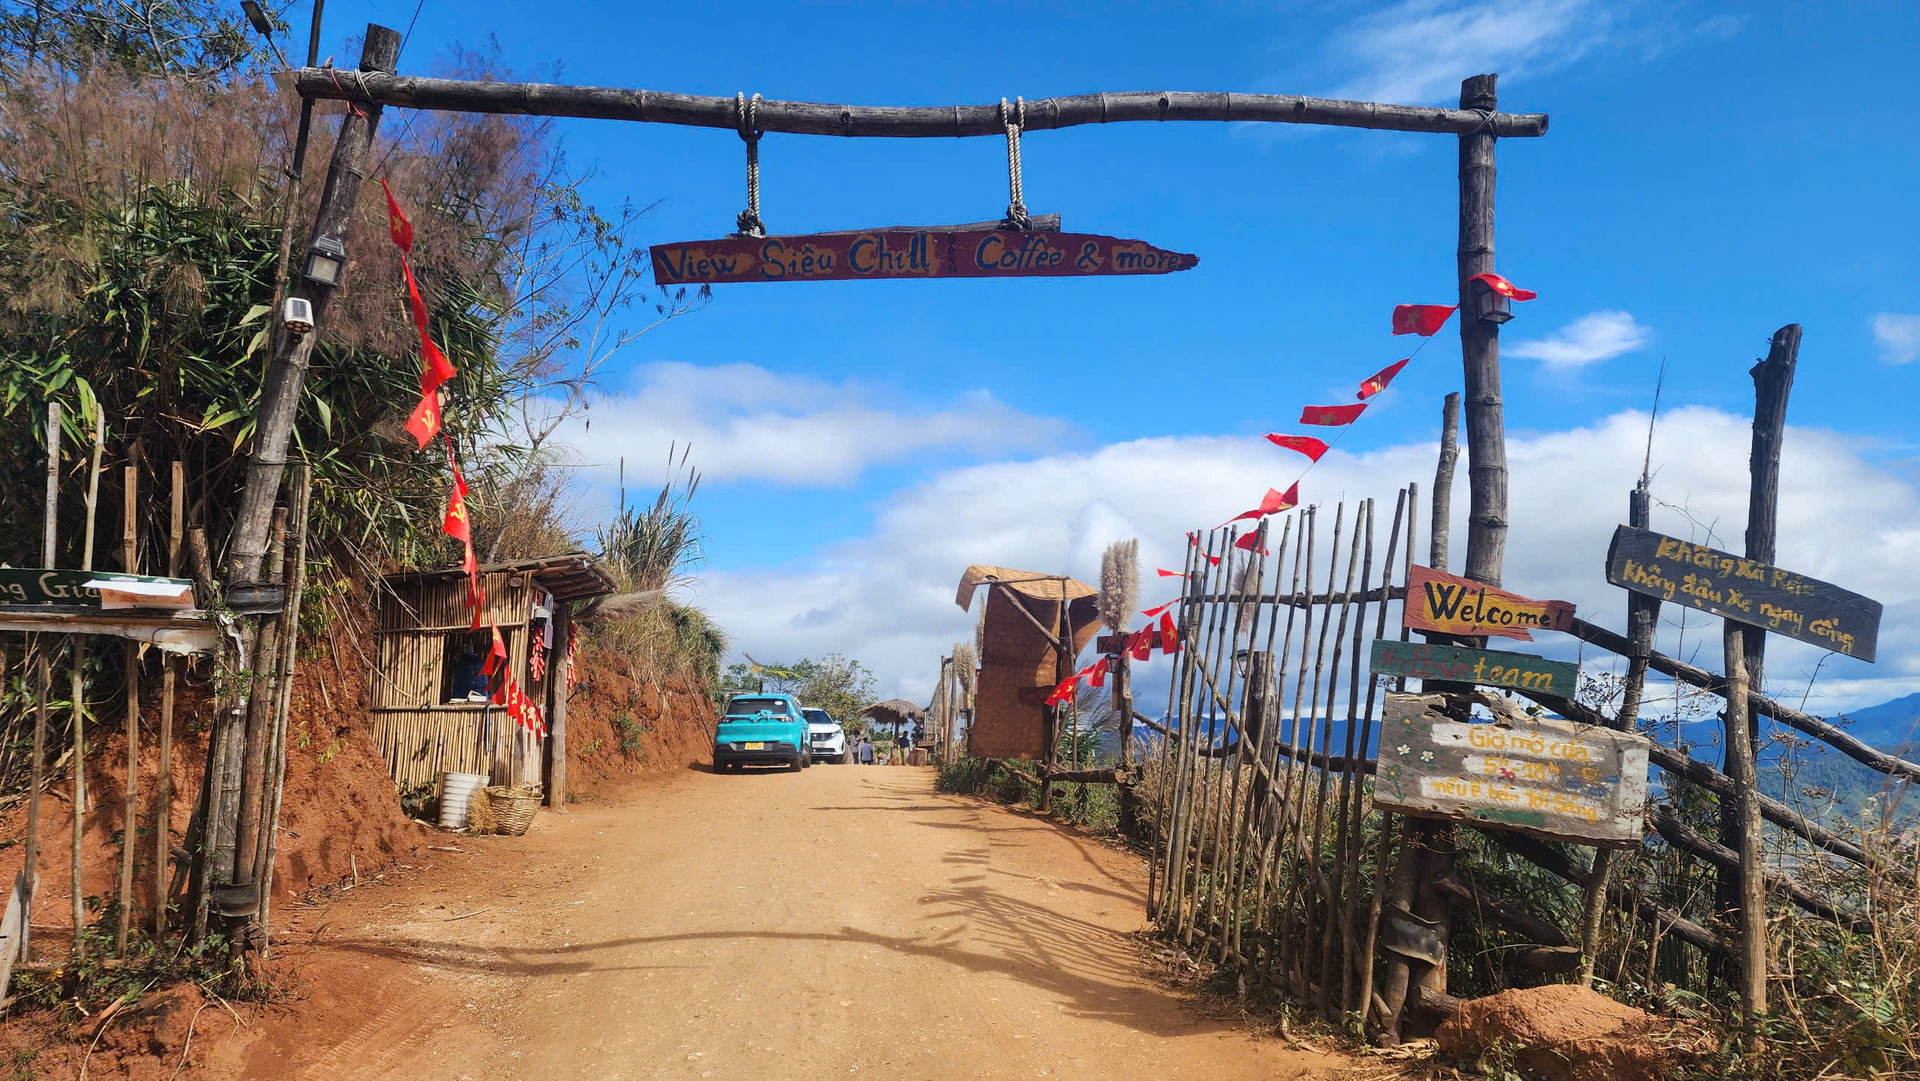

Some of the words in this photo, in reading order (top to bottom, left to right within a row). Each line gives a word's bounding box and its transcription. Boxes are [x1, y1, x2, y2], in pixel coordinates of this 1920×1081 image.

[658, 246, 736, 280] View
[760, 240, 834, 279] Siêu
[848, 234, 930, 273] Chill
[975, 236, 1064, 270] Coffee
[1076, 242, 1100, 269] &
[1424, 581, 1563, 629] Welcome!
[1760, 603, 1804, 637] ngay
